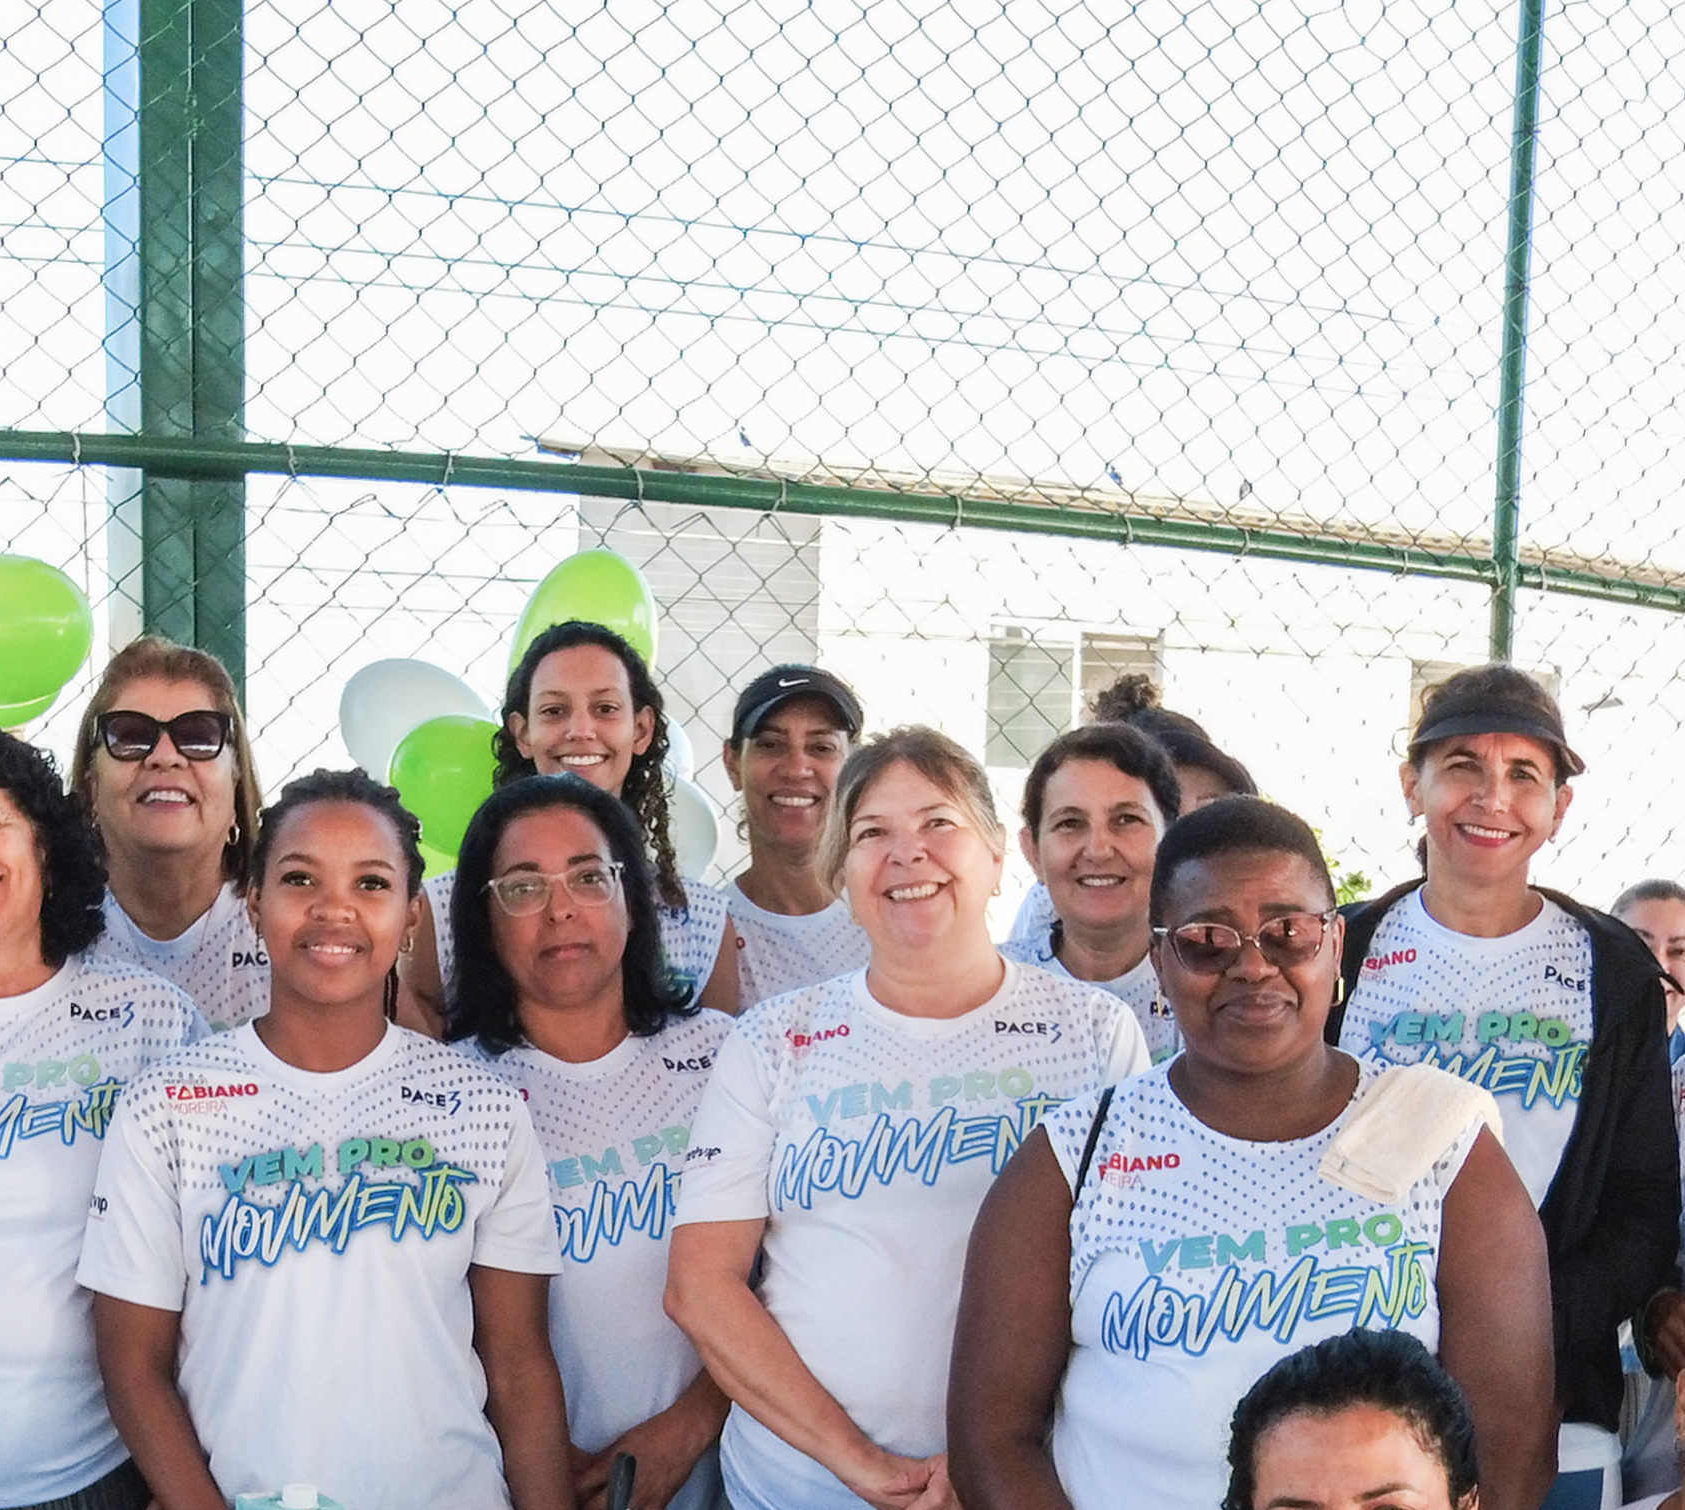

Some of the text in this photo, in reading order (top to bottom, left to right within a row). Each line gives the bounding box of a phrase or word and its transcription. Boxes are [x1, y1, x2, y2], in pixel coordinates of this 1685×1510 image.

[1369, 1010, 1571, 1048] VEM PRO
[2, 1053, 101, 1093] PRO
[165, 1082, 260, 1100] FABIANO
[805, 1066, 1034, 1127] VEM PRO
[219, 1137, 434, 1195] VEM PRO
[199, 1163, 479, 1286] MOVIMENTO
[1140, 1211, 1403, 1275] VEM PRO
[1099, 1239, 1433, 1361] MOVIMENTO
